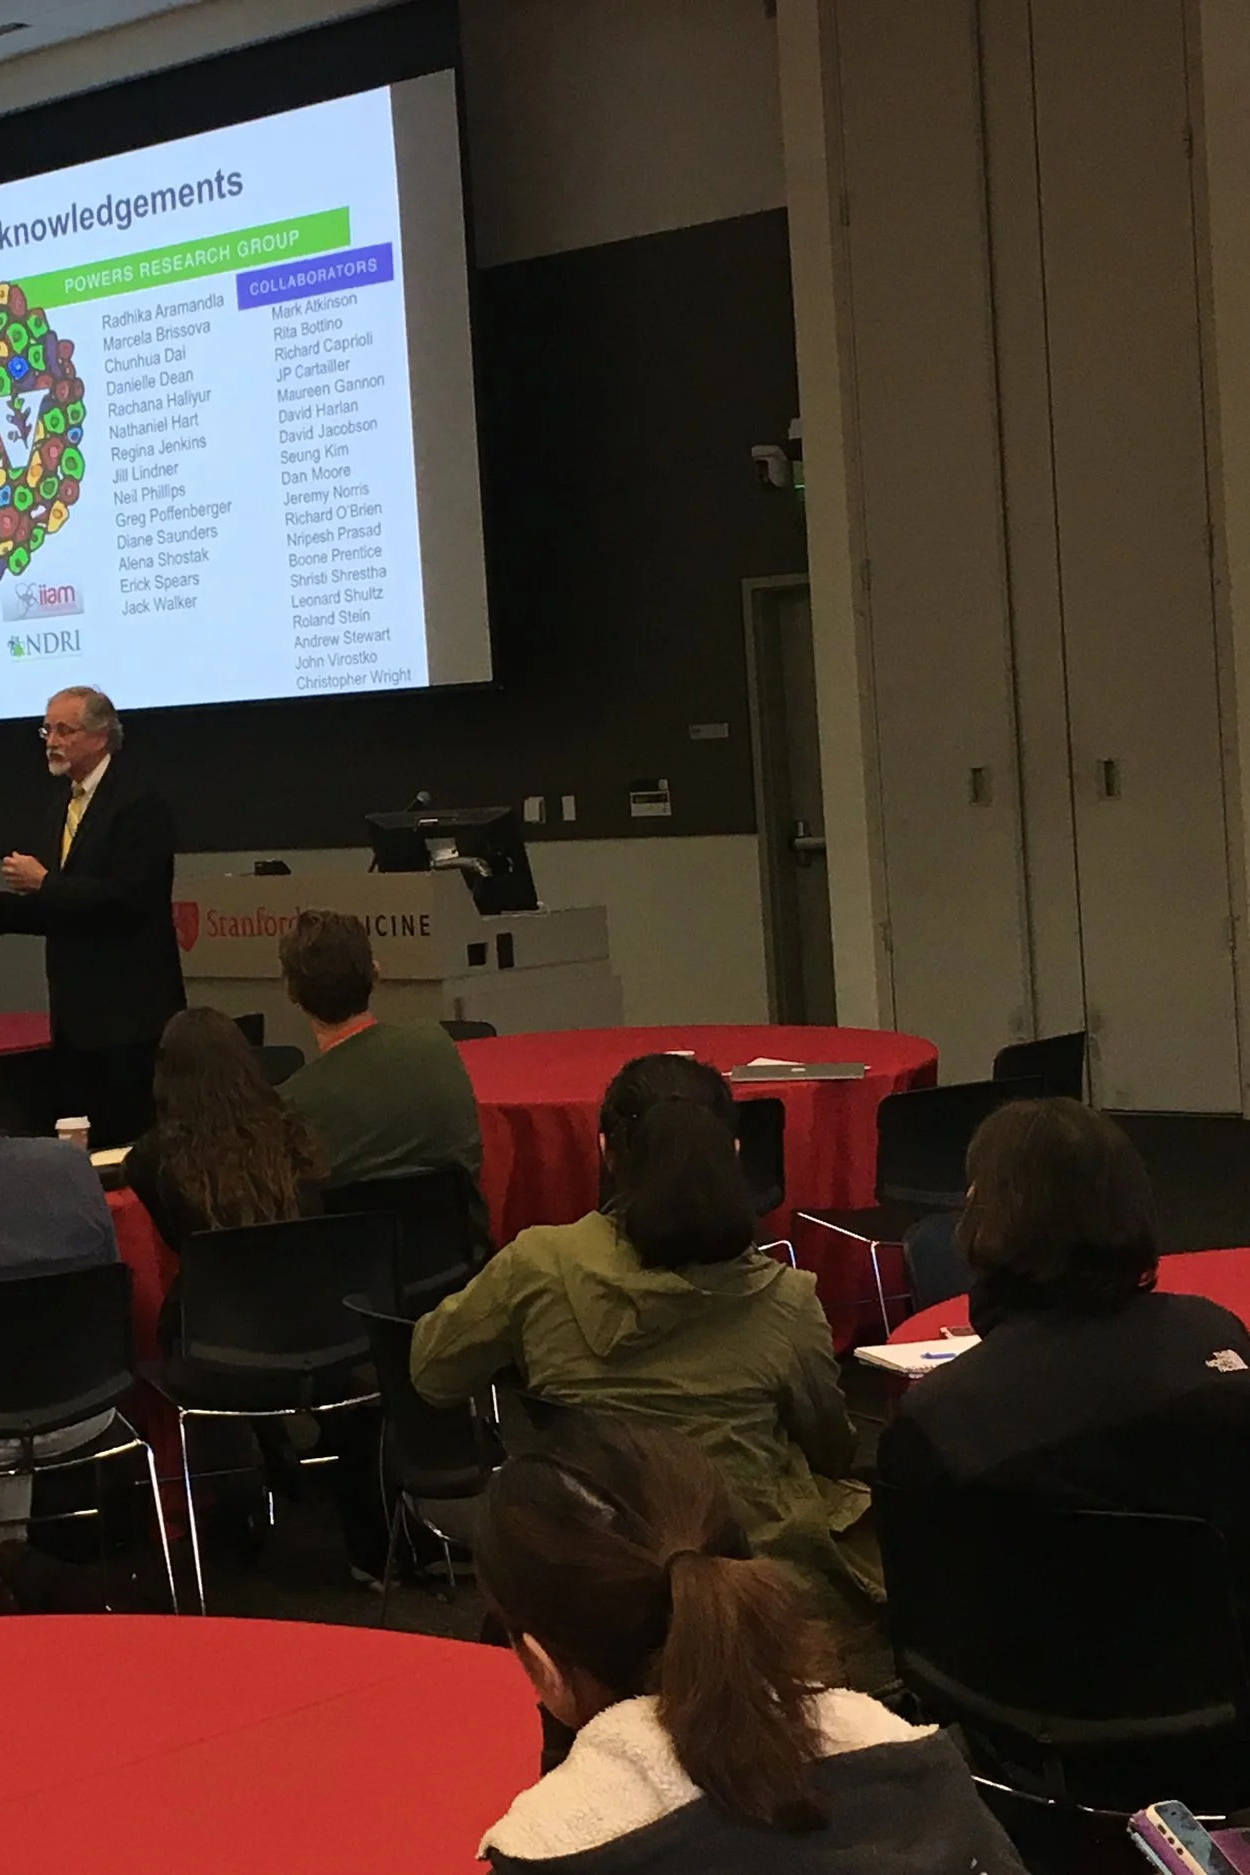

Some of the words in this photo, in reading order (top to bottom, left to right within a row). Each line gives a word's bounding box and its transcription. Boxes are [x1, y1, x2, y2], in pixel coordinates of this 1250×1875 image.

[64, 266, 133, 293] POWERS
[139, 244, 231, 279] RESEARCH
[237, 229, 300, 258] GROUP
[250, 257, 378, 296] COLLABORATORS
[102, 308, 152, 330] Radhika
[155, 293, 224, 319] Aramandla
[272, 305, 302, 321] Mark
[305, 294, 358, 315] Atkinson
[103, 330, 152, 352] Marcela
[156, 320, 211, 342] Brissova
[273, 325, 297, 341] Rita
[301, 318, 343, 336] Bottino
[275, 340, 320, 362] Richard
[323, 331, 373, 353] Caprioli
[105, 353, 161, 374] Chunhua
[165, 345, 186, 363] Dai
[276, 367, 291, 383] JP
[295, 358, 350, 379] Cartailler
[106, 375, 156, 396] Danielle
[160, 369, 193, 387] Dean
[277, 384, 330, 403] Maureen
[334, 375, 385, 394] Gannon
[108, 397, 163, 418] Rachana
[167, 389, 212, 409] Haliyur
[279, 405, 312, 424] David
[316, 400, 358, 419] Harlan
[109, 417, 168, 440] Nathaniel
[172, 412, 199, 431] Hart
[279, 426, 313, 444] David
[318, 418, 377, 438] Jacobson
[111, 443, 155, 463] Regina
[158, 436, 207, 455] Jenkins
[280, 449, 321, 465] Seung
[324, 444, 349, 458] Kim
[112, 468, 128, 484] Jill
[132, 463, 179, 481] Lindner
[281, 471, 308, 485] Dan
[311, 465, 351, 481] Moore
[114, 489, 137, 506] Neil
[142, 484, 186, 502] Phillips
[283, 490, 329, 506] Jeremy
[333, 482, 370, 500] Norris
[115, 512, 146, 528] Greg
[150, 501, 232, 523] Poffenberger
[285, 507, 333, 526] Richard
[117, 533, 153, 550] Diane
[157, 525, 218, 545] Saunders
[287, 529, 334, 547] Nripesh
[337, 522, 382, 541] Prasad
[118, 555, 154, 571] Alena
[158, 548, 210, 567] Shostak
[289, 552, 328, 568] Boone
[331, 545, 382, 562] Prentice
[120, 577, 151, 593] Erick
[154, 573, 200, 591] Spears
[290, 571, 328, 588] Shristi
[331, 565, 387, 583] Shrestha
[38, 584, 76, 605] iiam
[122, 599, 150, 616] Jack
[153, 595, 198, 612] Walker
[291, 590, 340, 608] Leonard
[344, 586, 384, 603] Shultz
[293, 612, 335, 629] Roland
[338, 608, 370, 625] Stein
[26, 629, 81, 656] NDRI
[294, 634, 340, 649] Andrew
[343, 628, 391, 645] Stewart
[295, 655, 325, 670] John
[327, 651, 378, 667] Virostko
[296, 673, 367, 690] Christopher
[370, 668, 412, 685] Wright
[366, 913, 432, 937] ICINE
